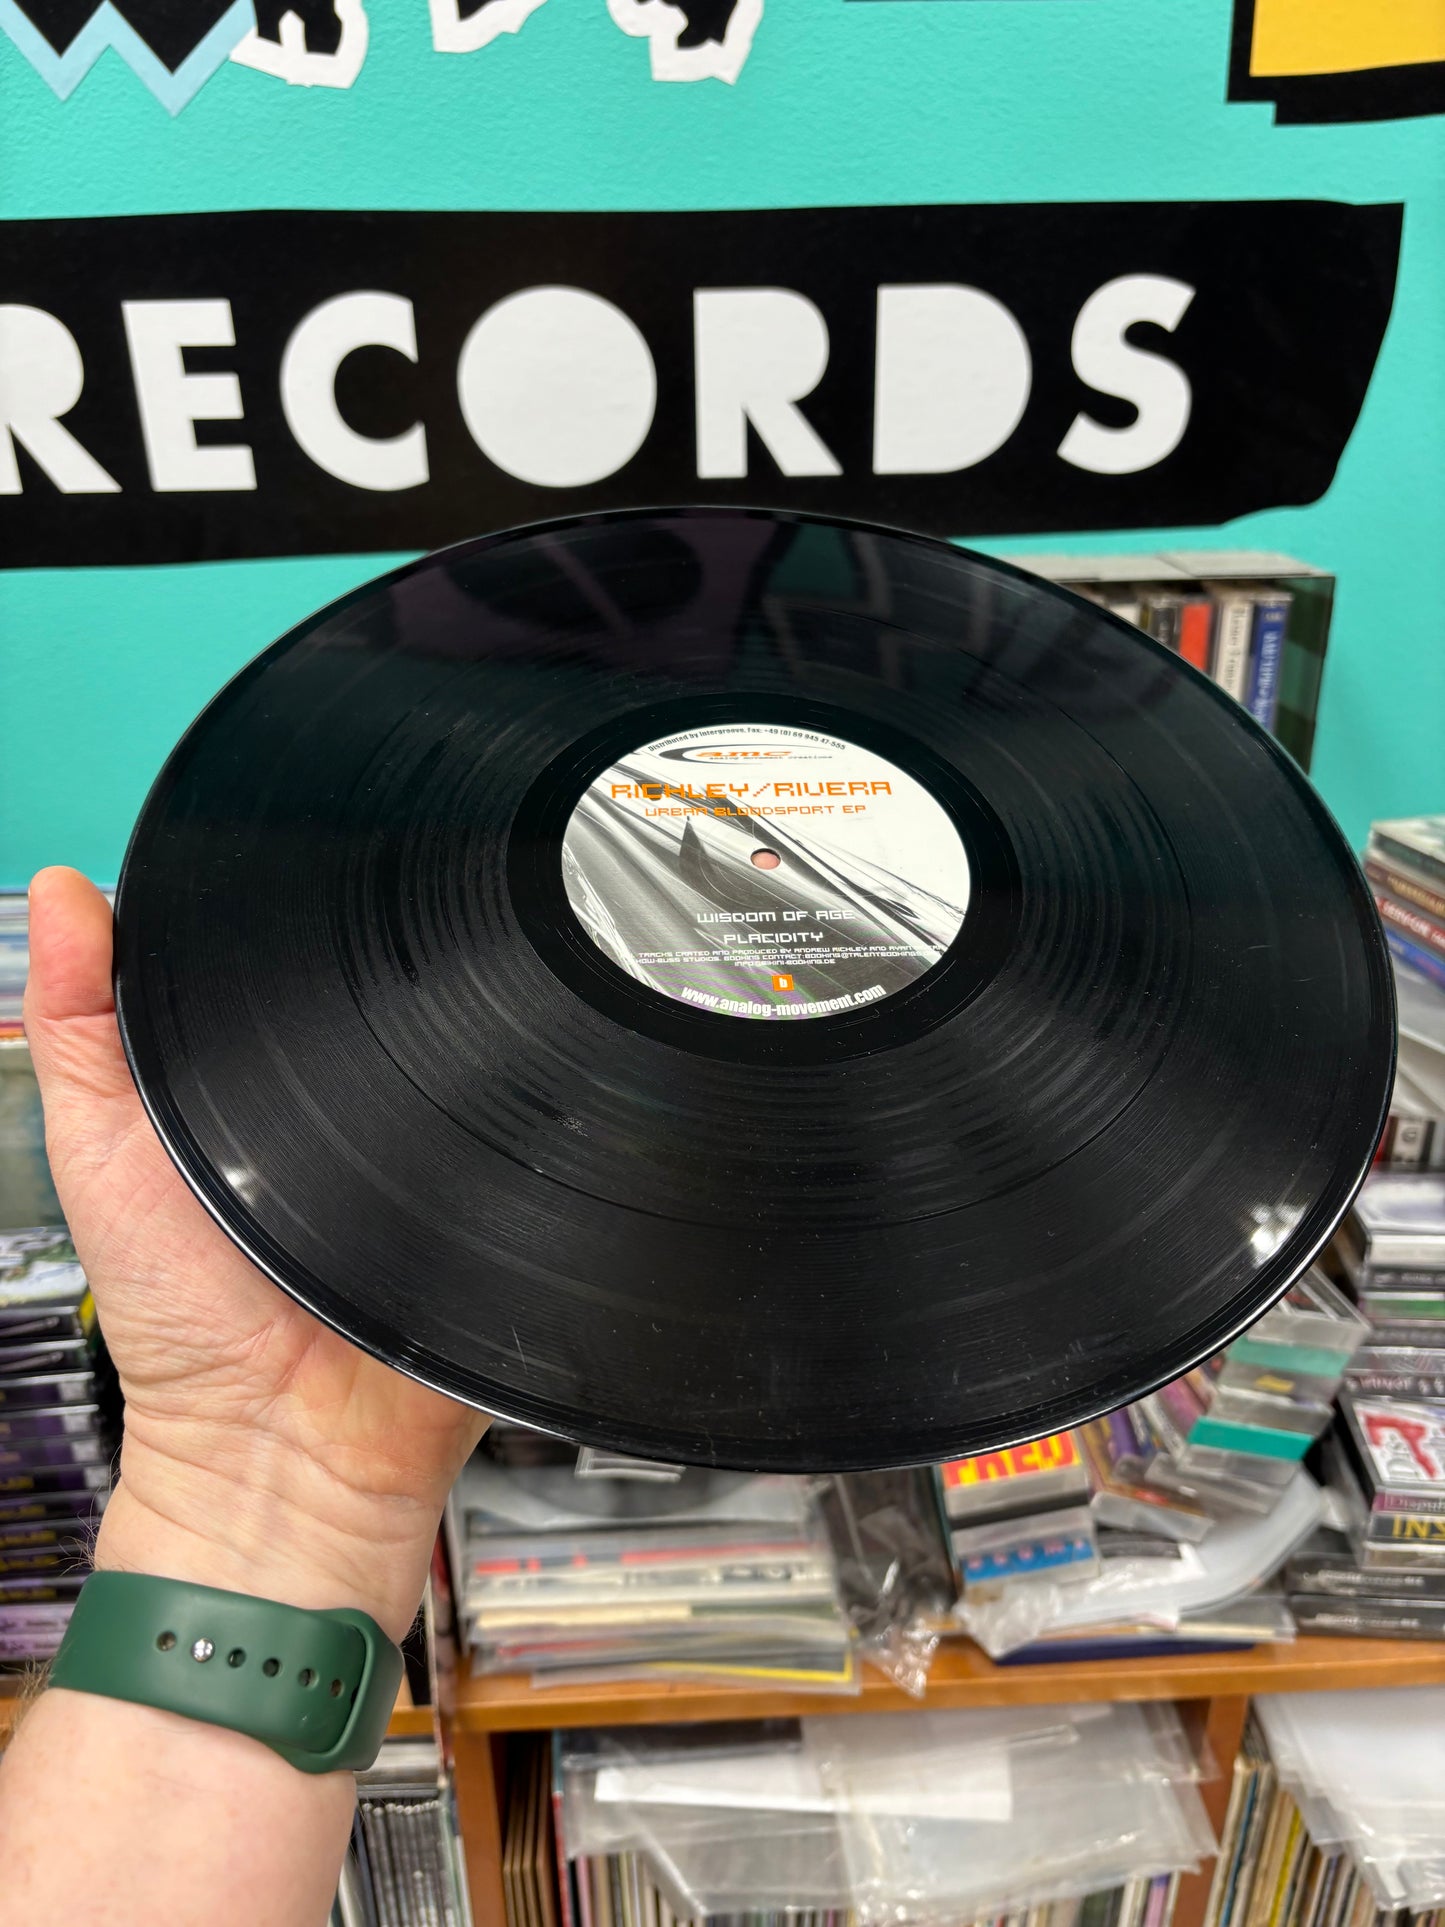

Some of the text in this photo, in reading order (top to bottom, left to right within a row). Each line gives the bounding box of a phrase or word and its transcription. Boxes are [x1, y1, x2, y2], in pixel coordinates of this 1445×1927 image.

[0, 273, 1195, 494] RECORDS
[648, 734, 689, 752] Distributed
[645, 804, 866, 817] URBAN BLOODSPORT EP
[697, 909, 856, 923] WISDOM OF AGE
[723, 932, 824, 945] PLACIDITY
[682, 985, 886, 1016] www.analog-movement.com
